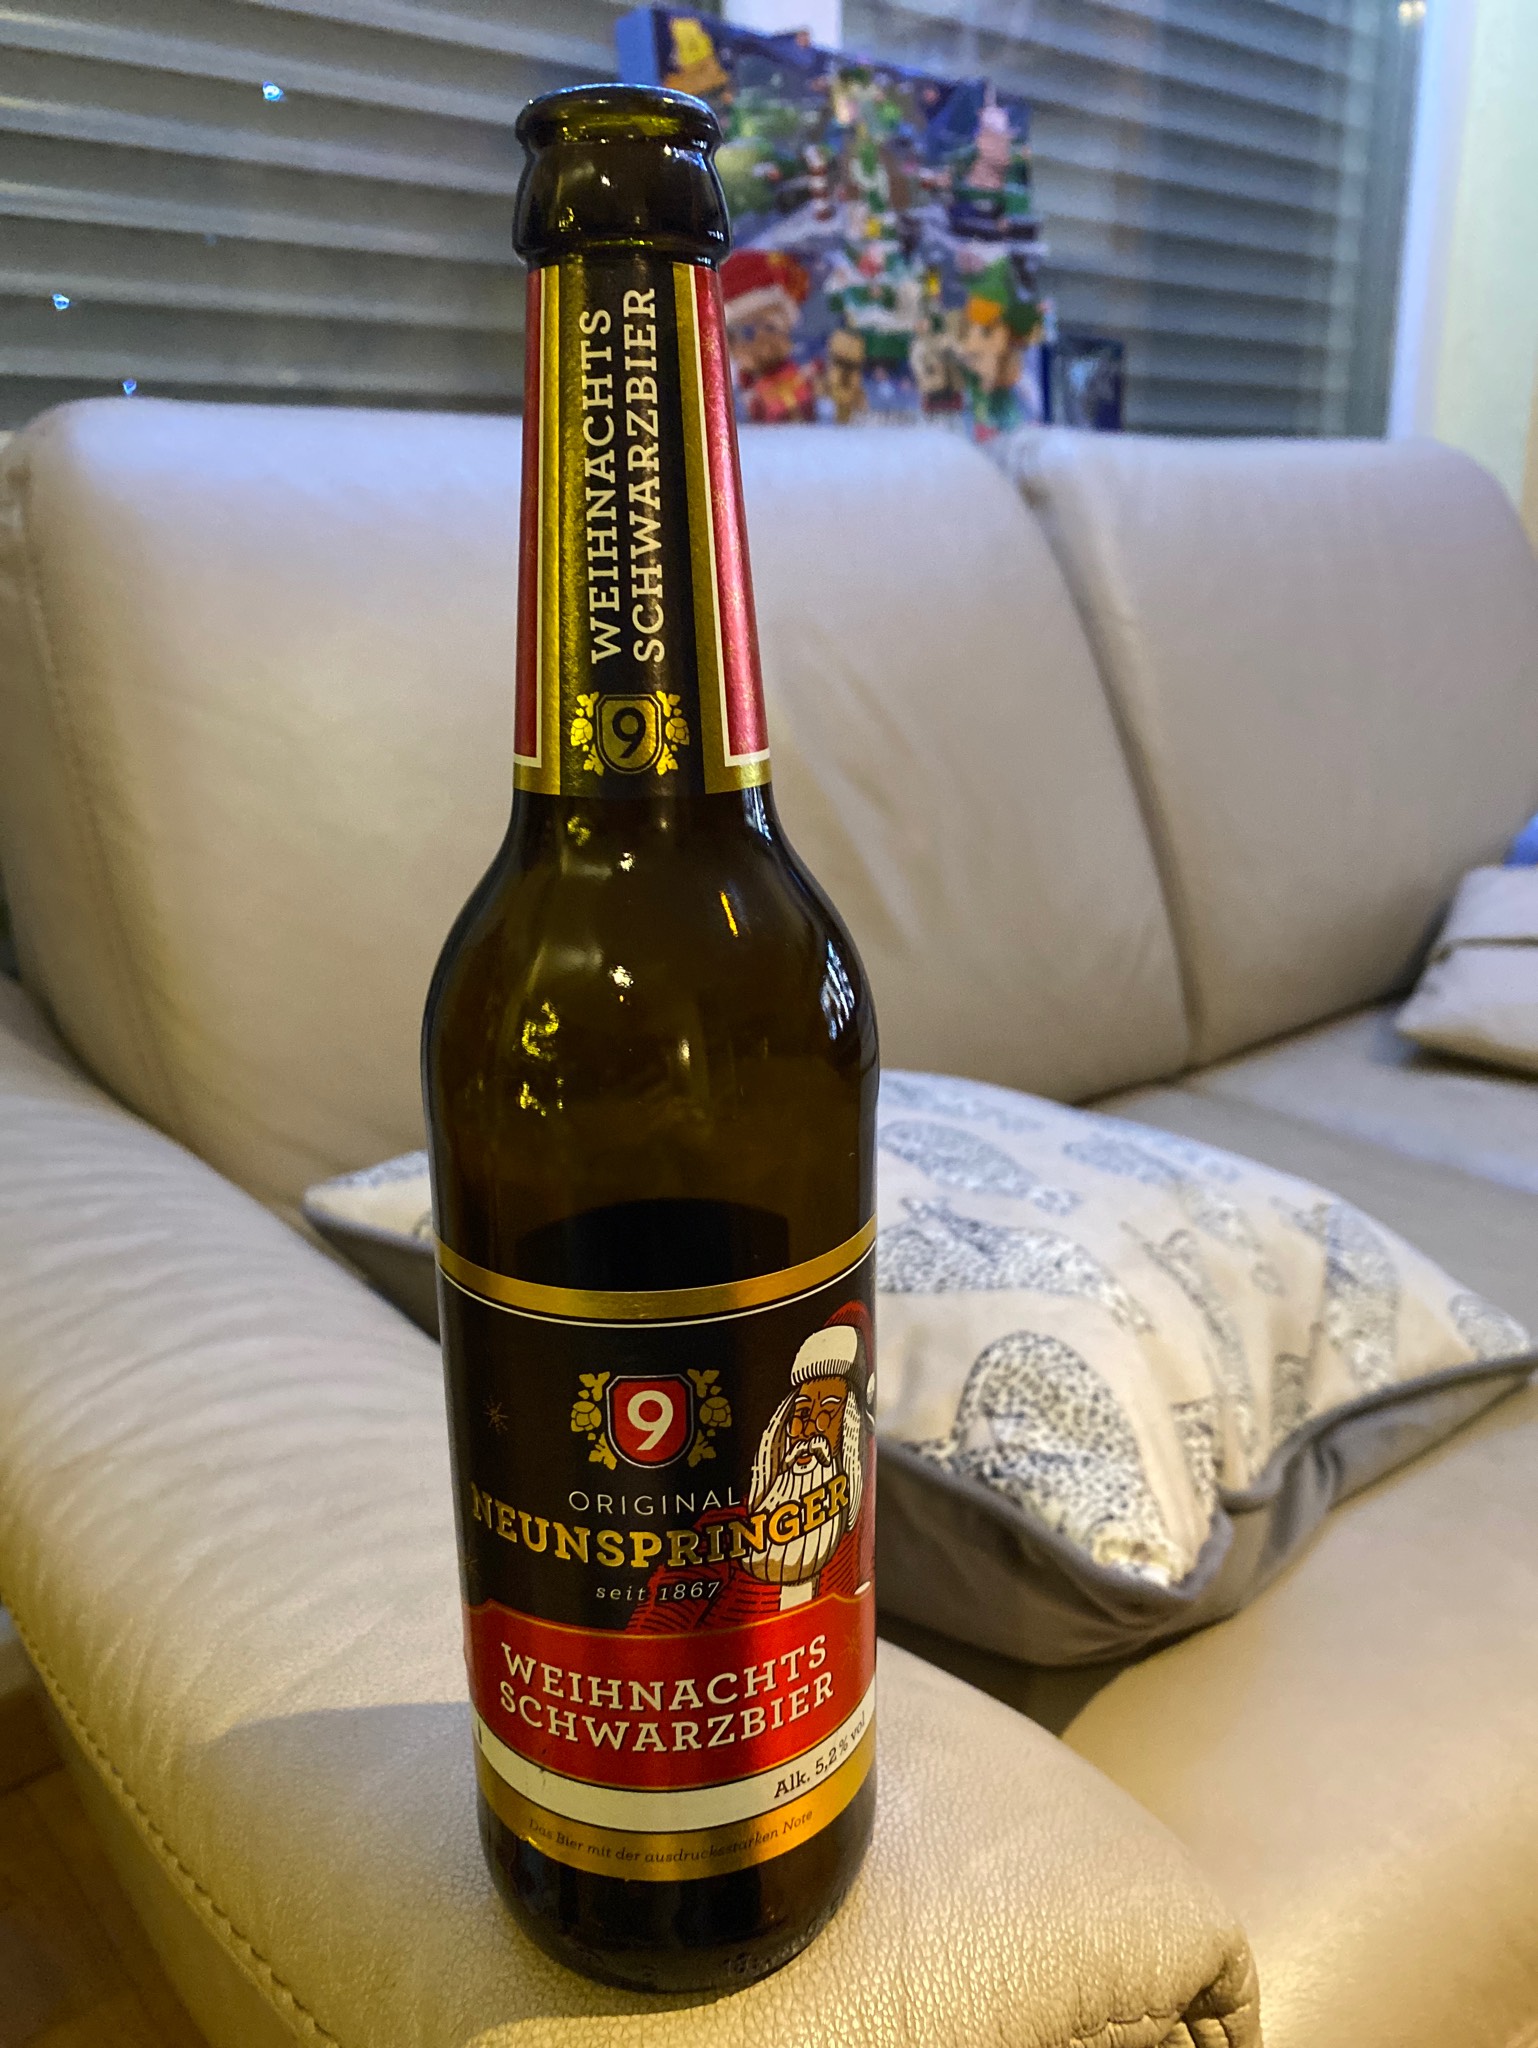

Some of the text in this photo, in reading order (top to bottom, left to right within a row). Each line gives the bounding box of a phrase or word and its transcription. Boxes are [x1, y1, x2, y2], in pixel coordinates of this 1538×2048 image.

[580, 308, 622, 665] WEIHNACHTS
[623, 288, 665, 662] SCHWARZBIER
[611, 707, 646, 759] 9
[626, 1390, 675, 1451] 9
[471, 1473, 850, 1569] NEUNSPRINGER
[569, 1486, 741, 1516] ORIGINAL
[596, 1581, 720, 1601] seit 1867
[501, 1634, 827, 1711] WEIHNACHTS
[500, 1671, 834, 1752] SCHWARZBIER
[774, 1770, 810, 1798] Alk.
[529, 1818, 552, 1840] Das
[556, 1832, 583, 1850] Bier
[587, 1844, 611, 1858] mit
[615, 1847, 640, 1861] der
[782, 1810, 813, 1835] Note
